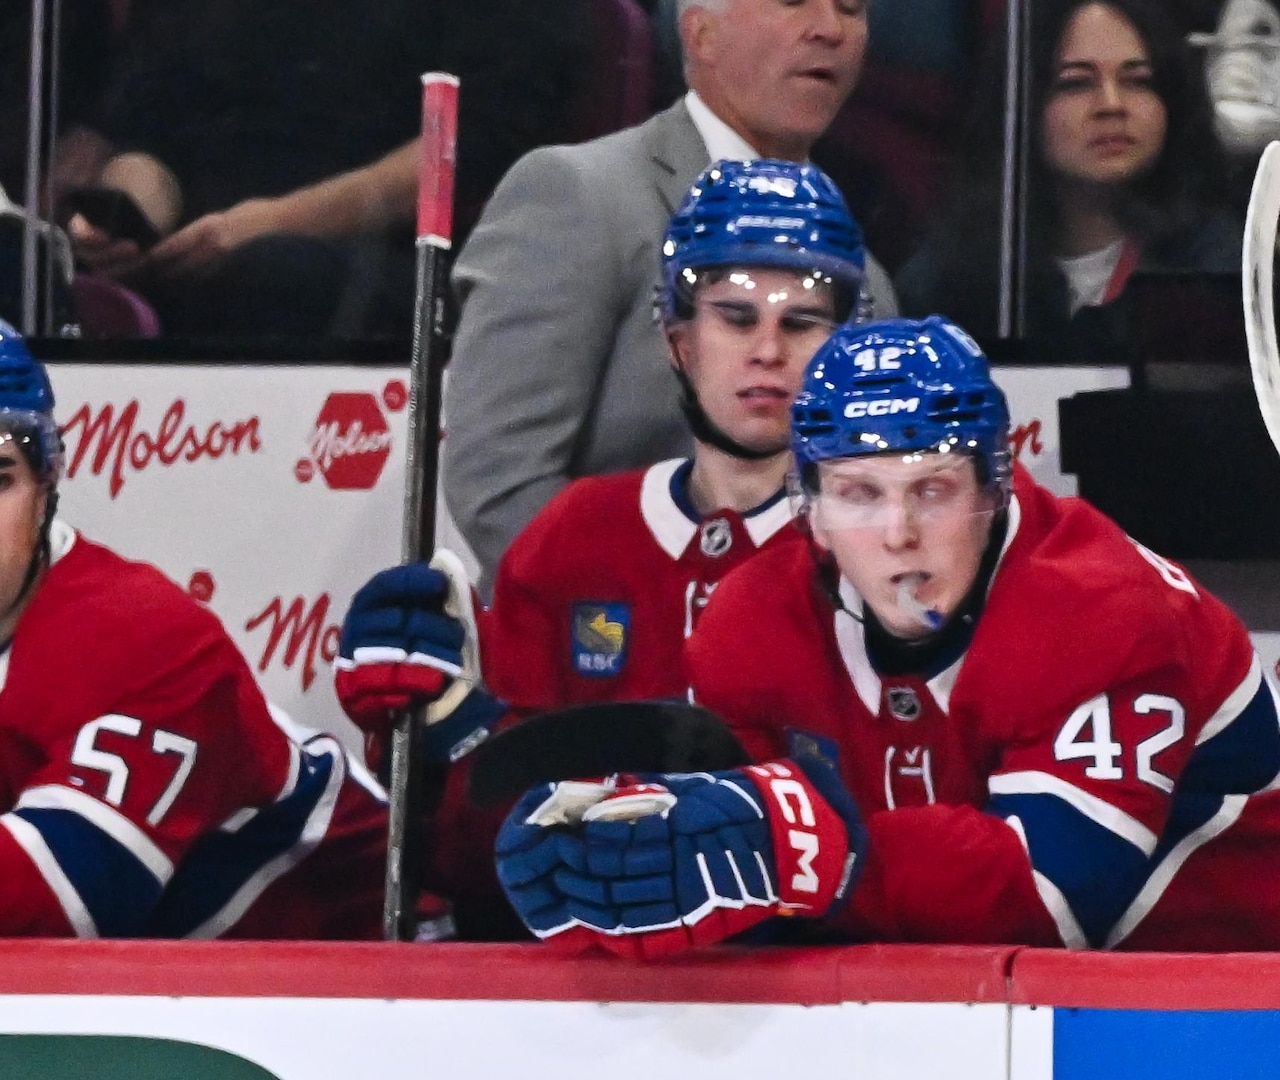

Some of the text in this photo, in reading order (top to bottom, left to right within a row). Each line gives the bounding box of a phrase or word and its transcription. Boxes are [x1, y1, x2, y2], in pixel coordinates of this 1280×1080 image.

[843, 397, 920, 418] CCM
[854, 347, 901, 371] 42
[56, 398, 261, 499] Molson
[71, 713, 198, 828] 57
[1054, 692, 1186, 794] 42
